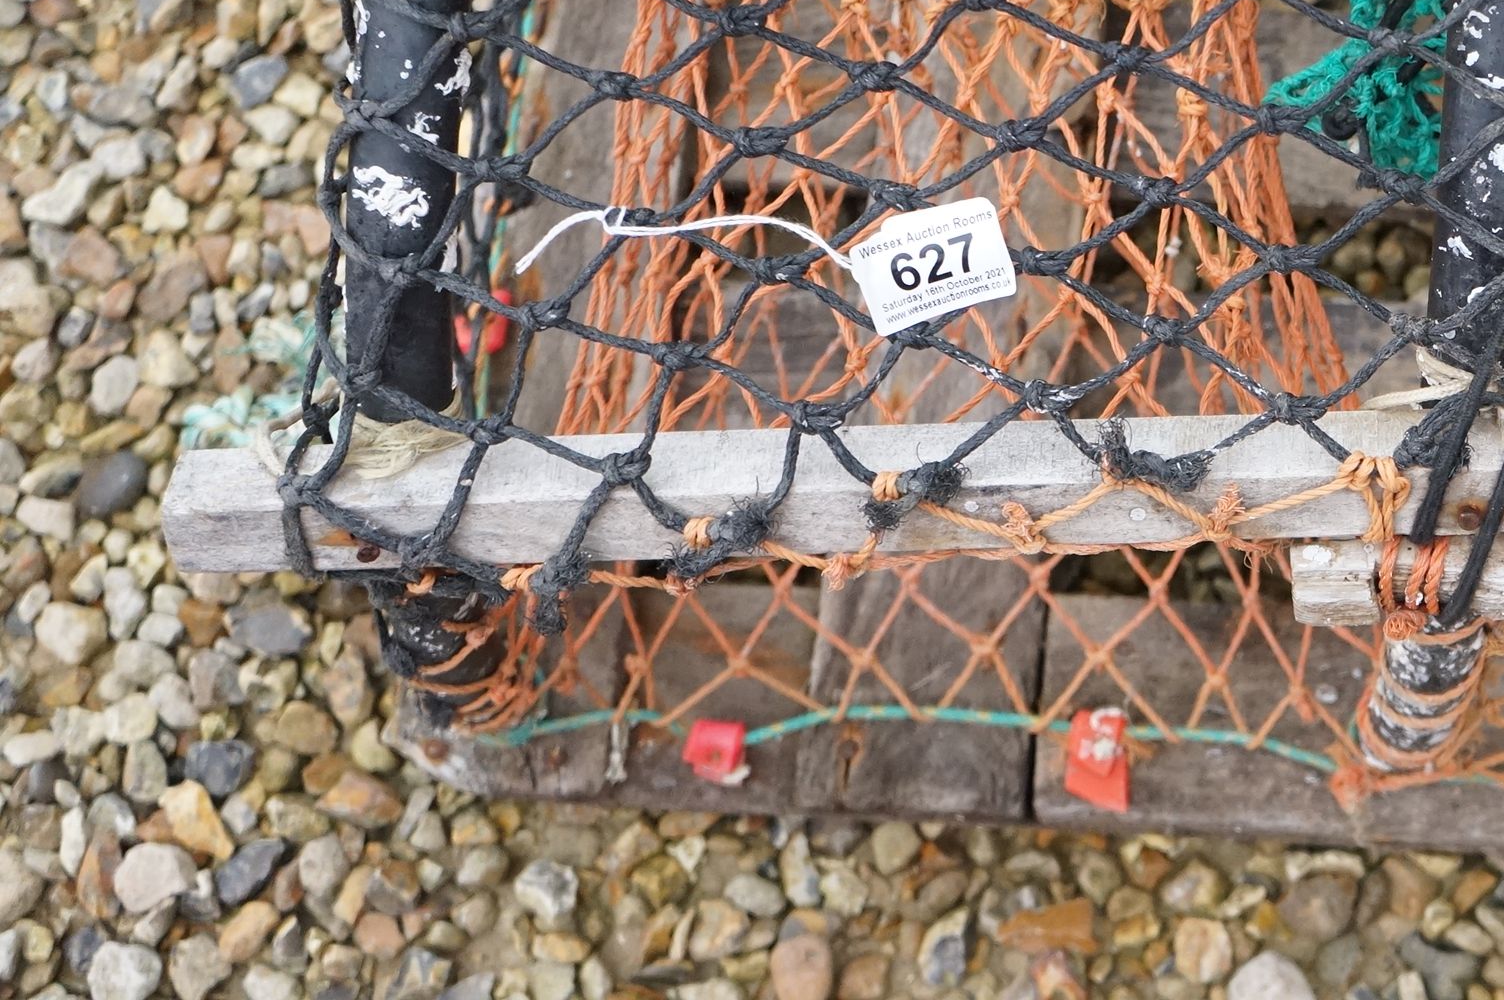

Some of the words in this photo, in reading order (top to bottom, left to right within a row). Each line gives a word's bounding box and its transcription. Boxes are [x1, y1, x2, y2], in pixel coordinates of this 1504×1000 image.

[859, 238, 903, 258] Wessex
[907, 222, 950, 242] Auction
[953, 210, 992, 229] Rooms
[891, 233, 973, 290] 627
[882, 292, 922, 312] Saturday
[926, 285, 945, 296] 16th
[948, 275, 982, 290] October
[985, 267, 1005, 279] 2021
[887, 278, 1011, 324] www.wessexauctionrooms.co.uk
